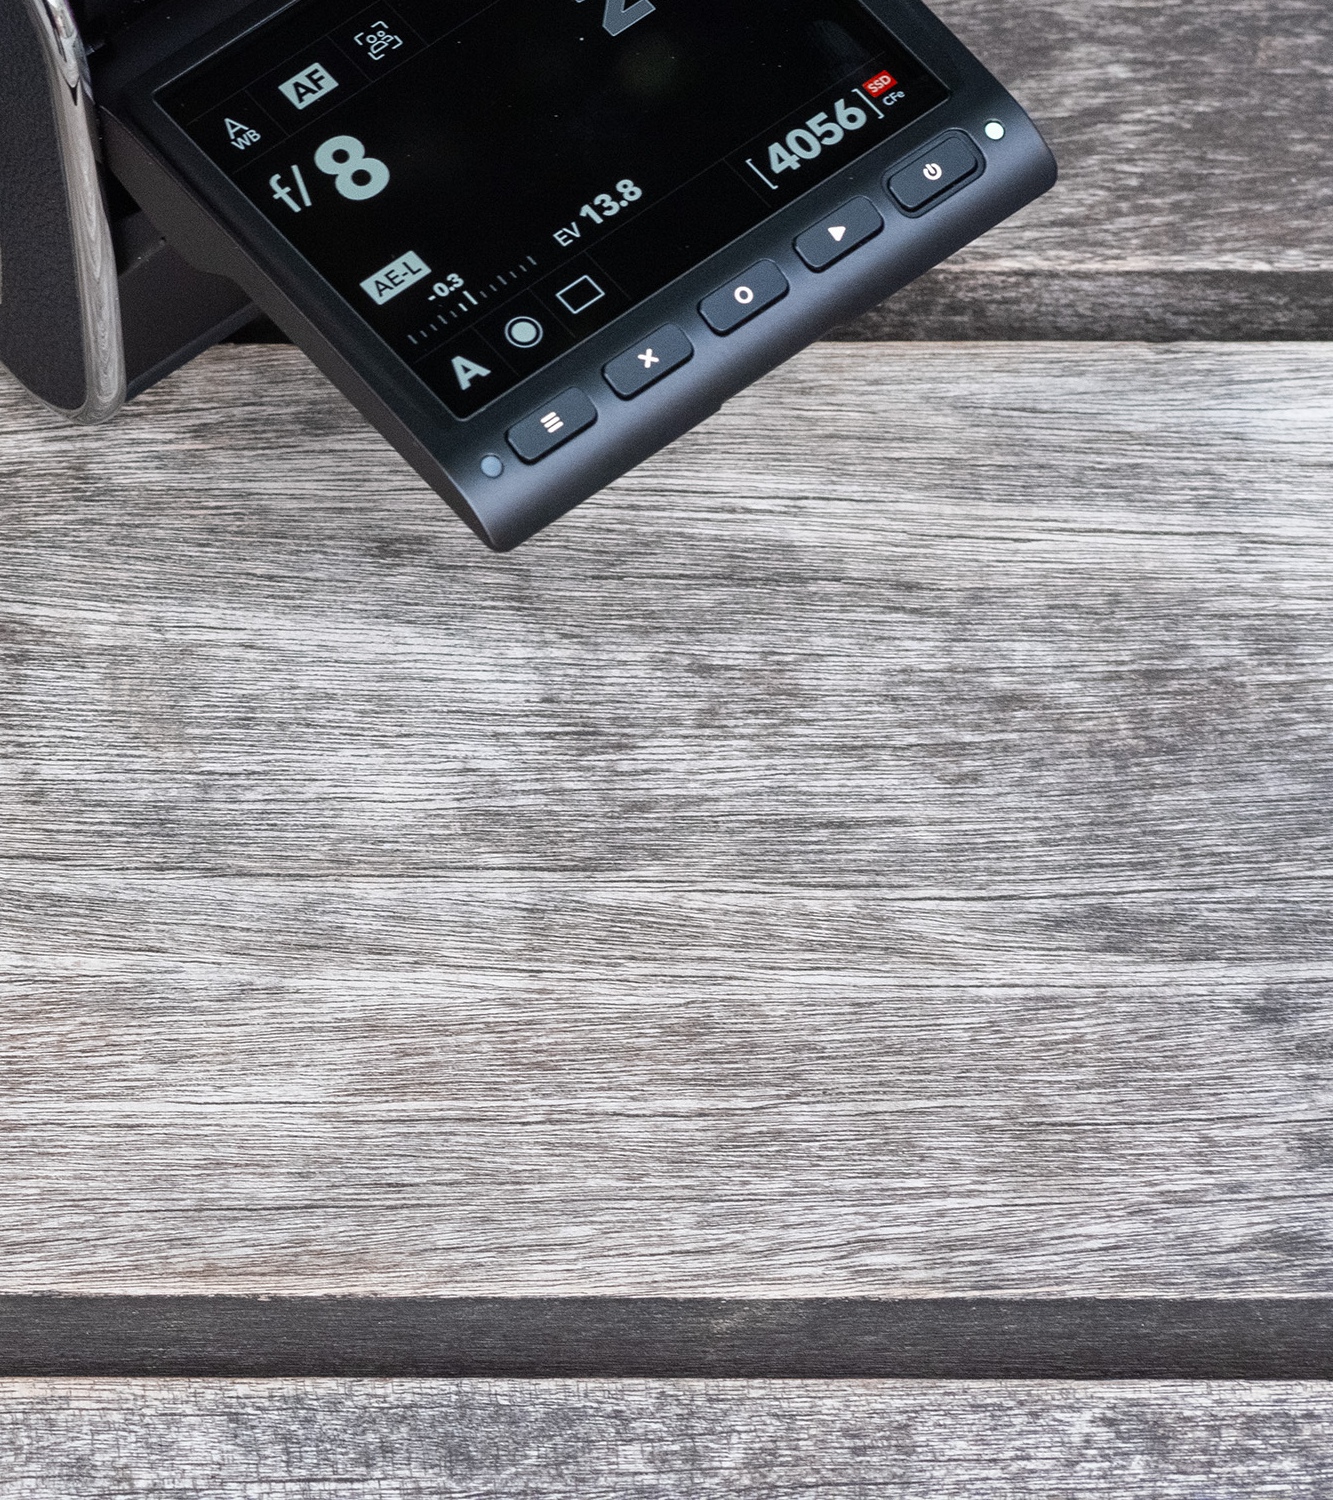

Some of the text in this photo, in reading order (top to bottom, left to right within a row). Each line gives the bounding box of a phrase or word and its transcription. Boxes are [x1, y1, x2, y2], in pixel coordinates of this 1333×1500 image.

[289, 66, 329, 106] AF
[866, 73, 894, 95] SSD
[882, 90, 906, 106] CFe
[552, 179, 643, 247] EV 13.8
[371, 258, 424, 300] AE-L
[428, 273, 465, 301] -0.3
[451, 355, 491, 390] A
